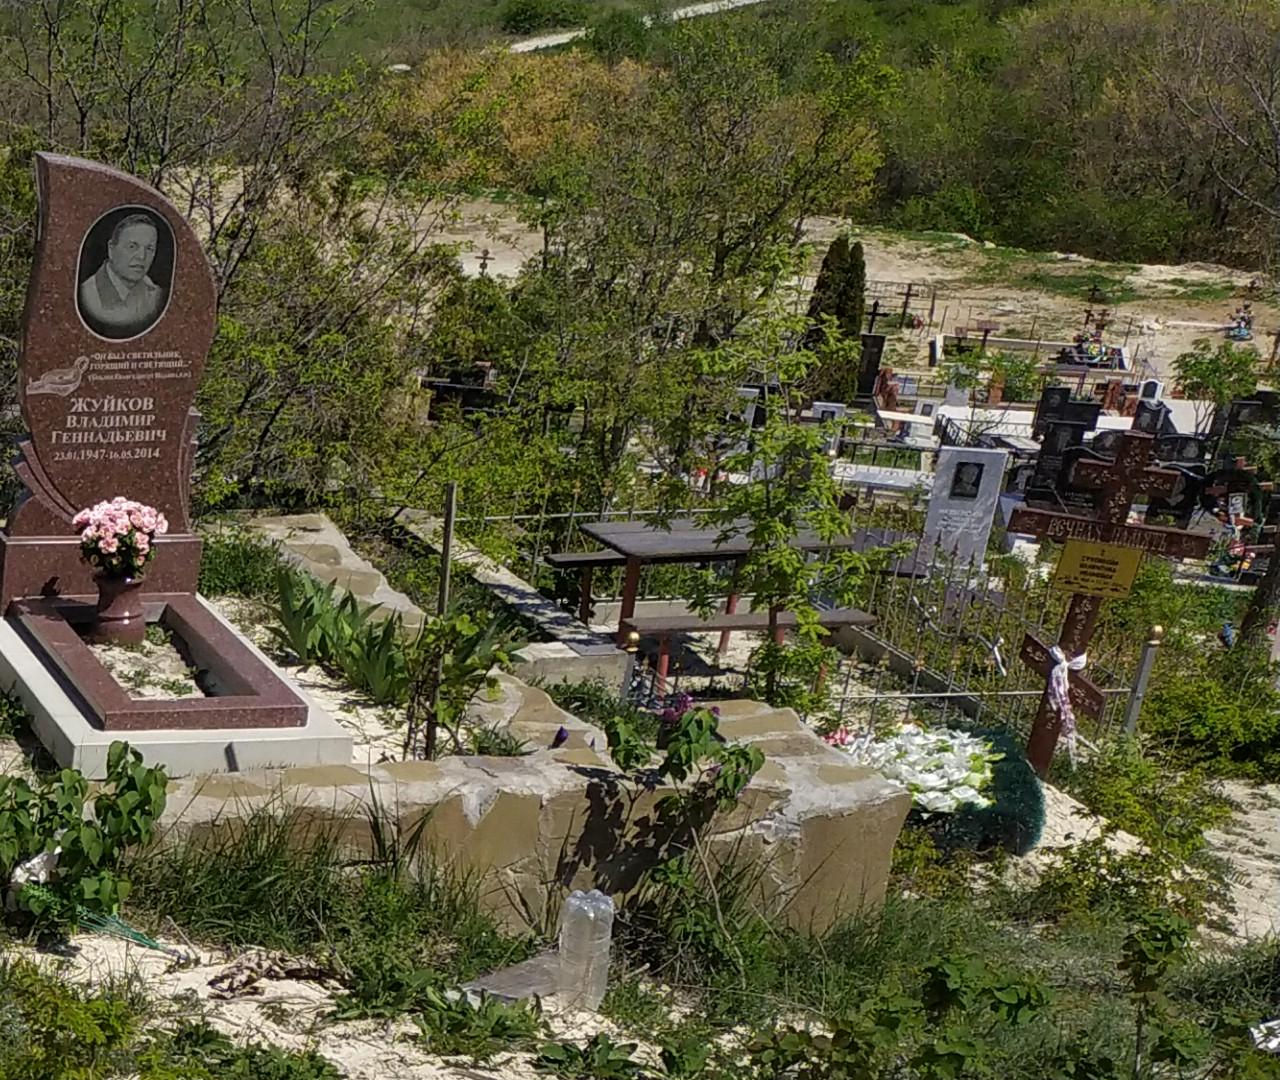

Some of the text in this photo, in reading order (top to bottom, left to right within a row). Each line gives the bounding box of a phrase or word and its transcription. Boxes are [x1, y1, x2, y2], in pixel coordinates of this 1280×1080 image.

[70, 395, 154, 412] ЖУЙКОВ
[66, 415, 156, 428] ВЛАДИМИР
[51, 430, 167, 444] ГЕННАДЬЕВИЧ
